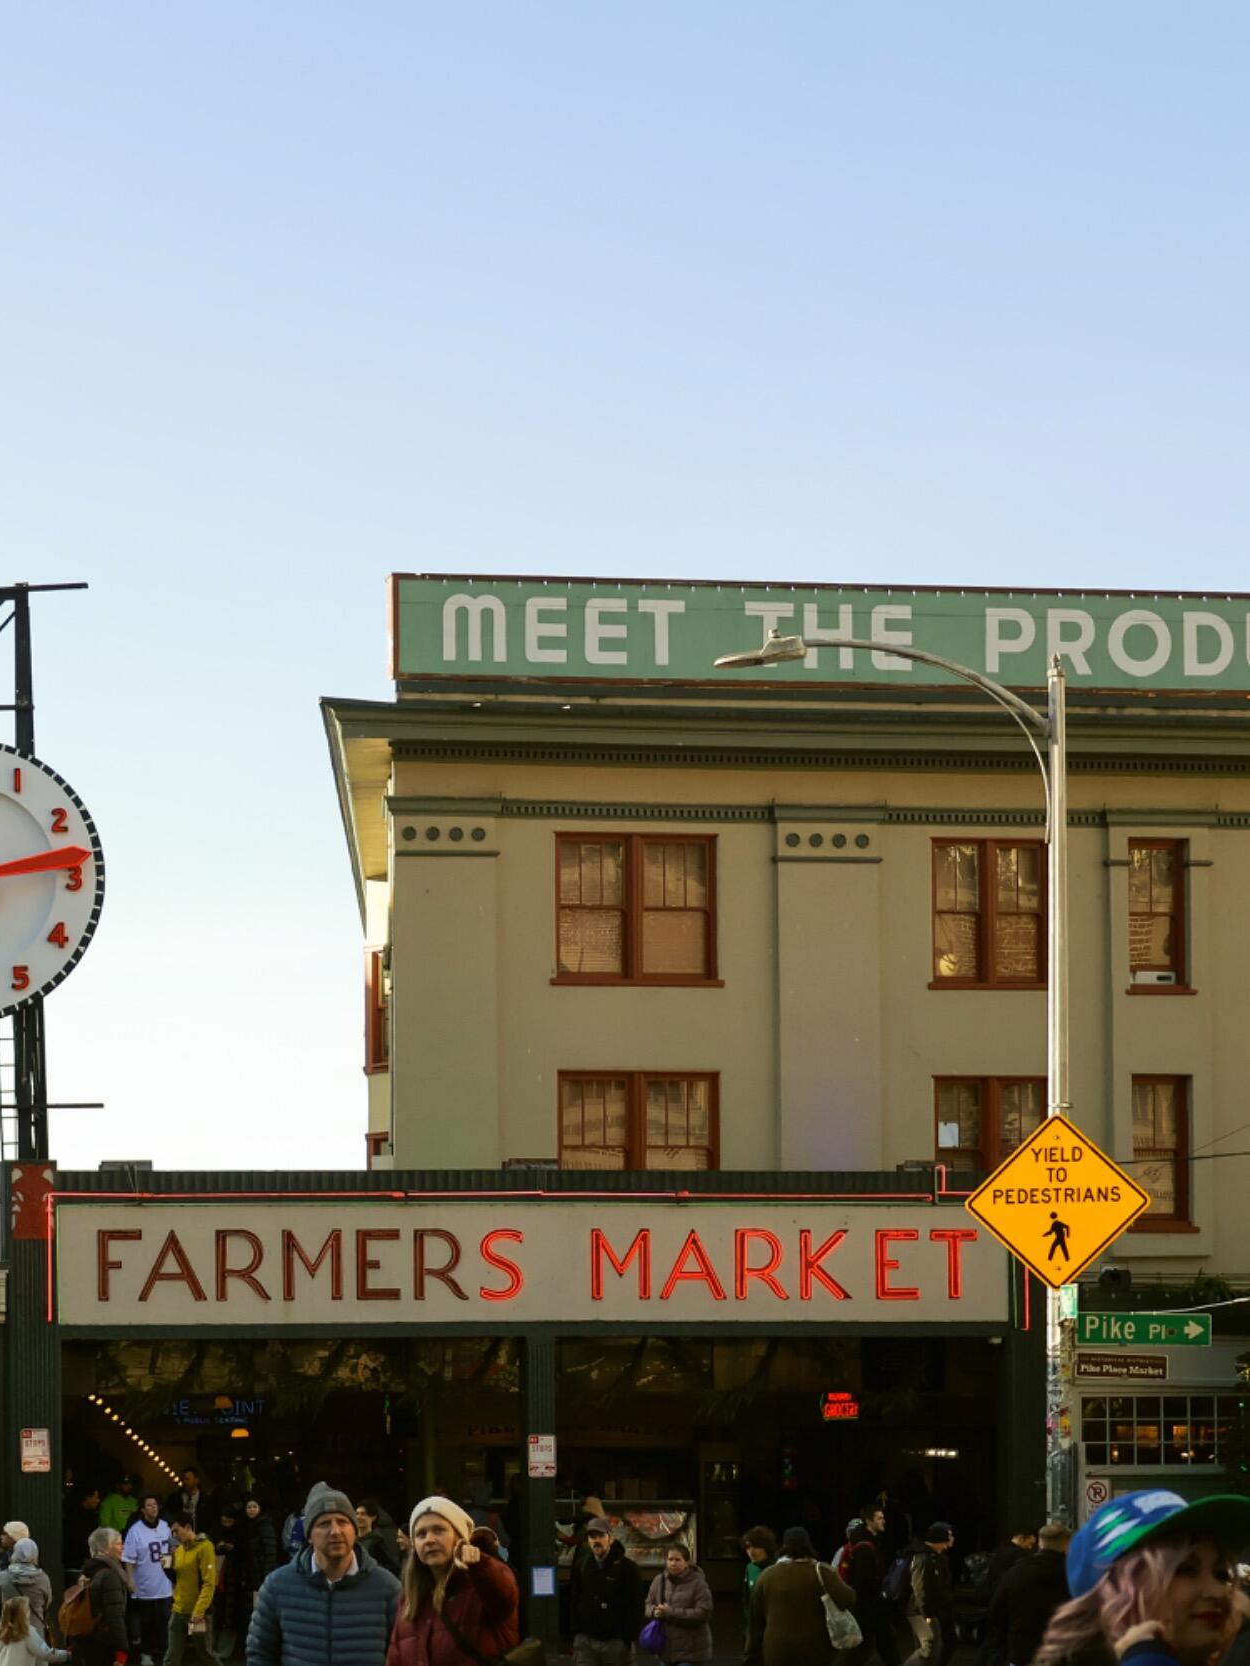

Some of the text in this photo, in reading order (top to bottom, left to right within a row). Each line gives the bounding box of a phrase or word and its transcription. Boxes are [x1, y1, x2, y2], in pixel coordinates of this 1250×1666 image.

[441, 593, 1250, 677] MEET THE PROD
[51, 807, 68, 833] 2
[65, 866, 82, 891] 3
[47, 922, 69, 948] 4
[11, 965, 29, 990] 5
[1031, 1147, 1083, 1163] YIELD
[1046, 1167, 1067, 1183] TO
[992, 1186, 1122, 1205] PEDESTRIANS
[97, 1227, 978, 1302] FARMERS MARKET
[1085, 1315, 1166, 1340] Pike Pl
[1080, 1364, 1163, 1376] Pike Place Market
